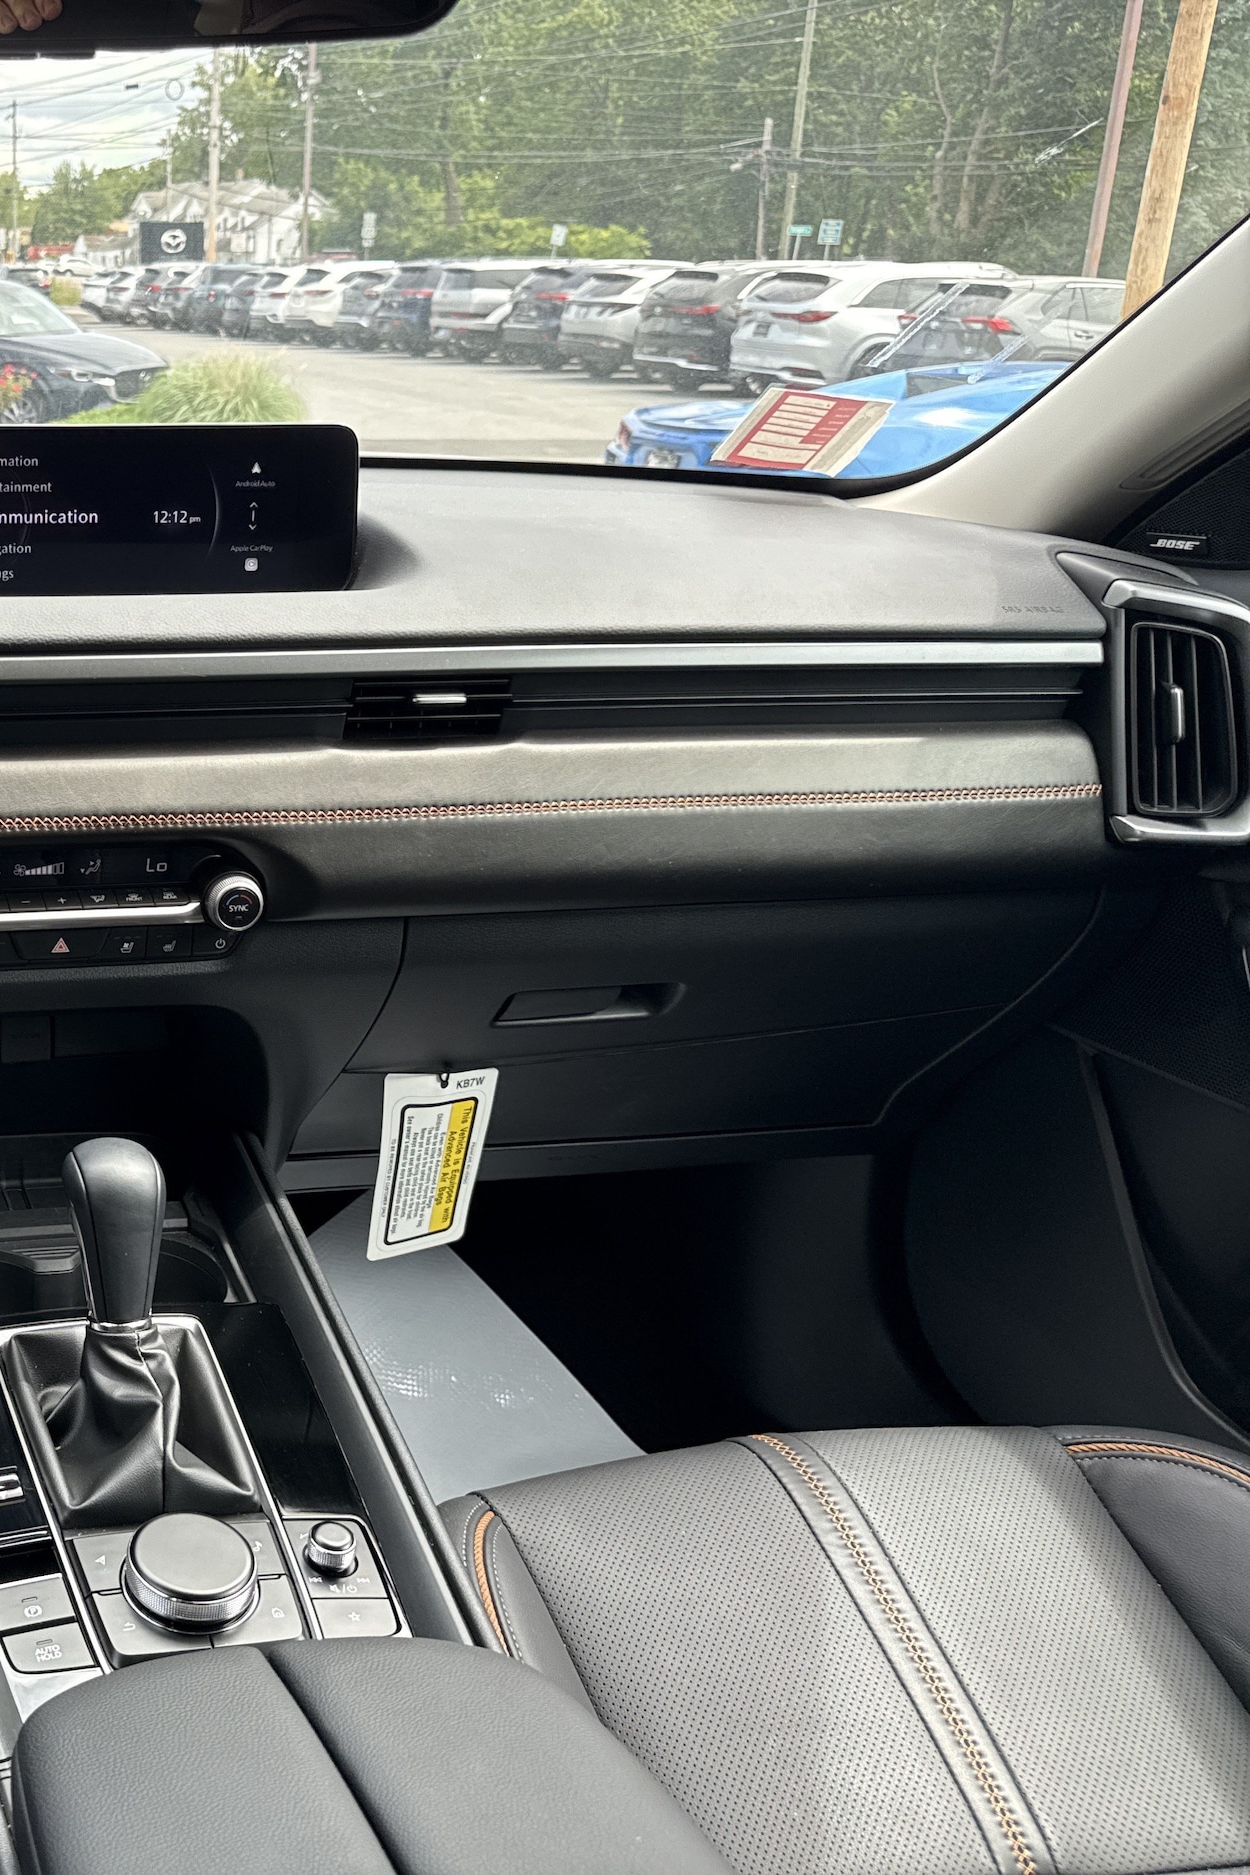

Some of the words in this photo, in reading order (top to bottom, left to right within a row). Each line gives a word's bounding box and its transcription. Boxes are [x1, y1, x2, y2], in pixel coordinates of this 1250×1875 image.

[153, 510, 188, 524] 12:12
[189, 516, 201, 524] pm
[230, 545, 249, 553] Apple
[250, 544, 273, 552] CarPlay
[1150, 538, 1200, 550] BOSE
[228, 904, 250, 913] SYNC
[456, 1076, 486, 1090] KB7W
[461, 1106, 472, 1123] This
[454, 1126, 468, 1154] Vehicle
[442, 1130, 457, 1168] Advanced
[452, 1157, 461, 1165] is
[439, 1171, 449, 1182] Air
[442, 1168, 459, 1204] Equipped
[433, 1186, 446, 1206] Bags
[440, 1206, 451, 1223] with
[35, 1644, 61, 1656] AUTO
[36, 1651, 63, 1663] HOLD
